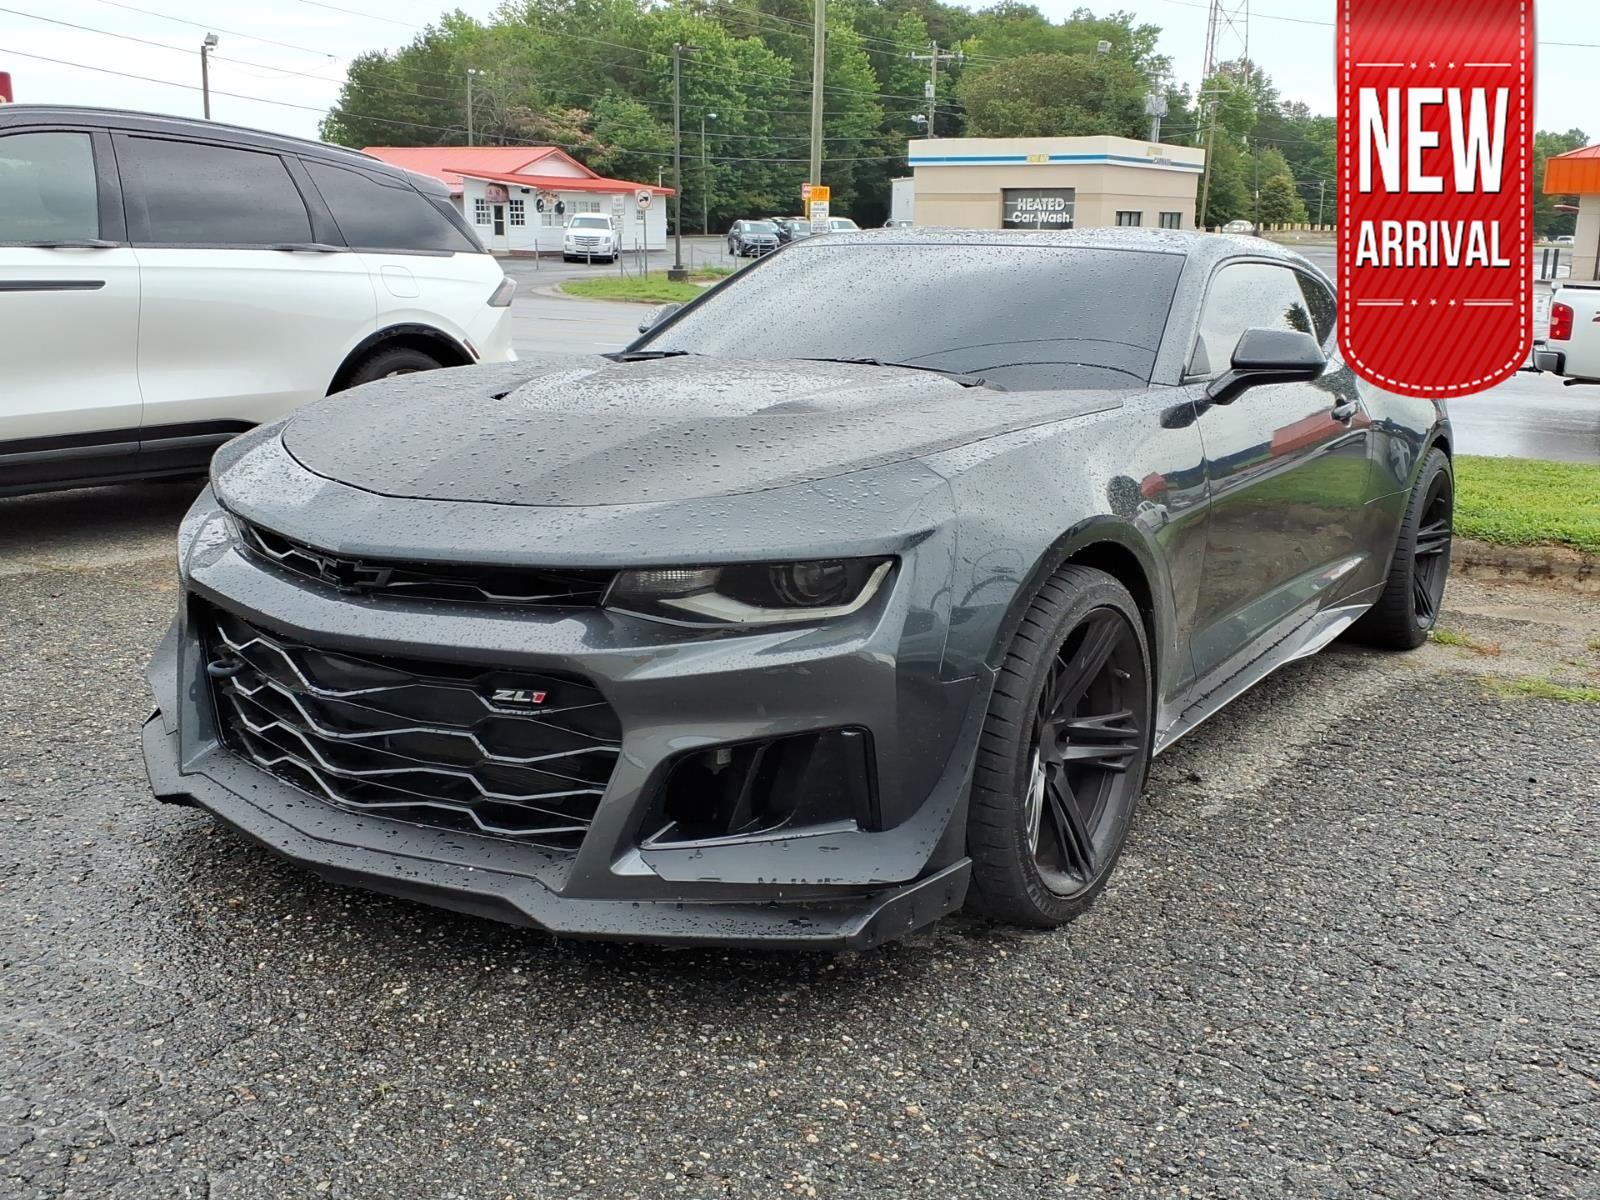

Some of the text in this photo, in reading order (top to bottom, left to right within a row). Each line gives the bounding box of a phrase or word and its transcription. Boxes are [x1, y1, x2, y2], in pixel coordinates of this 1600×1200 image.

[1017, 197, 1066, 211] HEATED
[1012, 211, 1070, 223] Car Wash
[492, 689, 546, 703] ZL1
